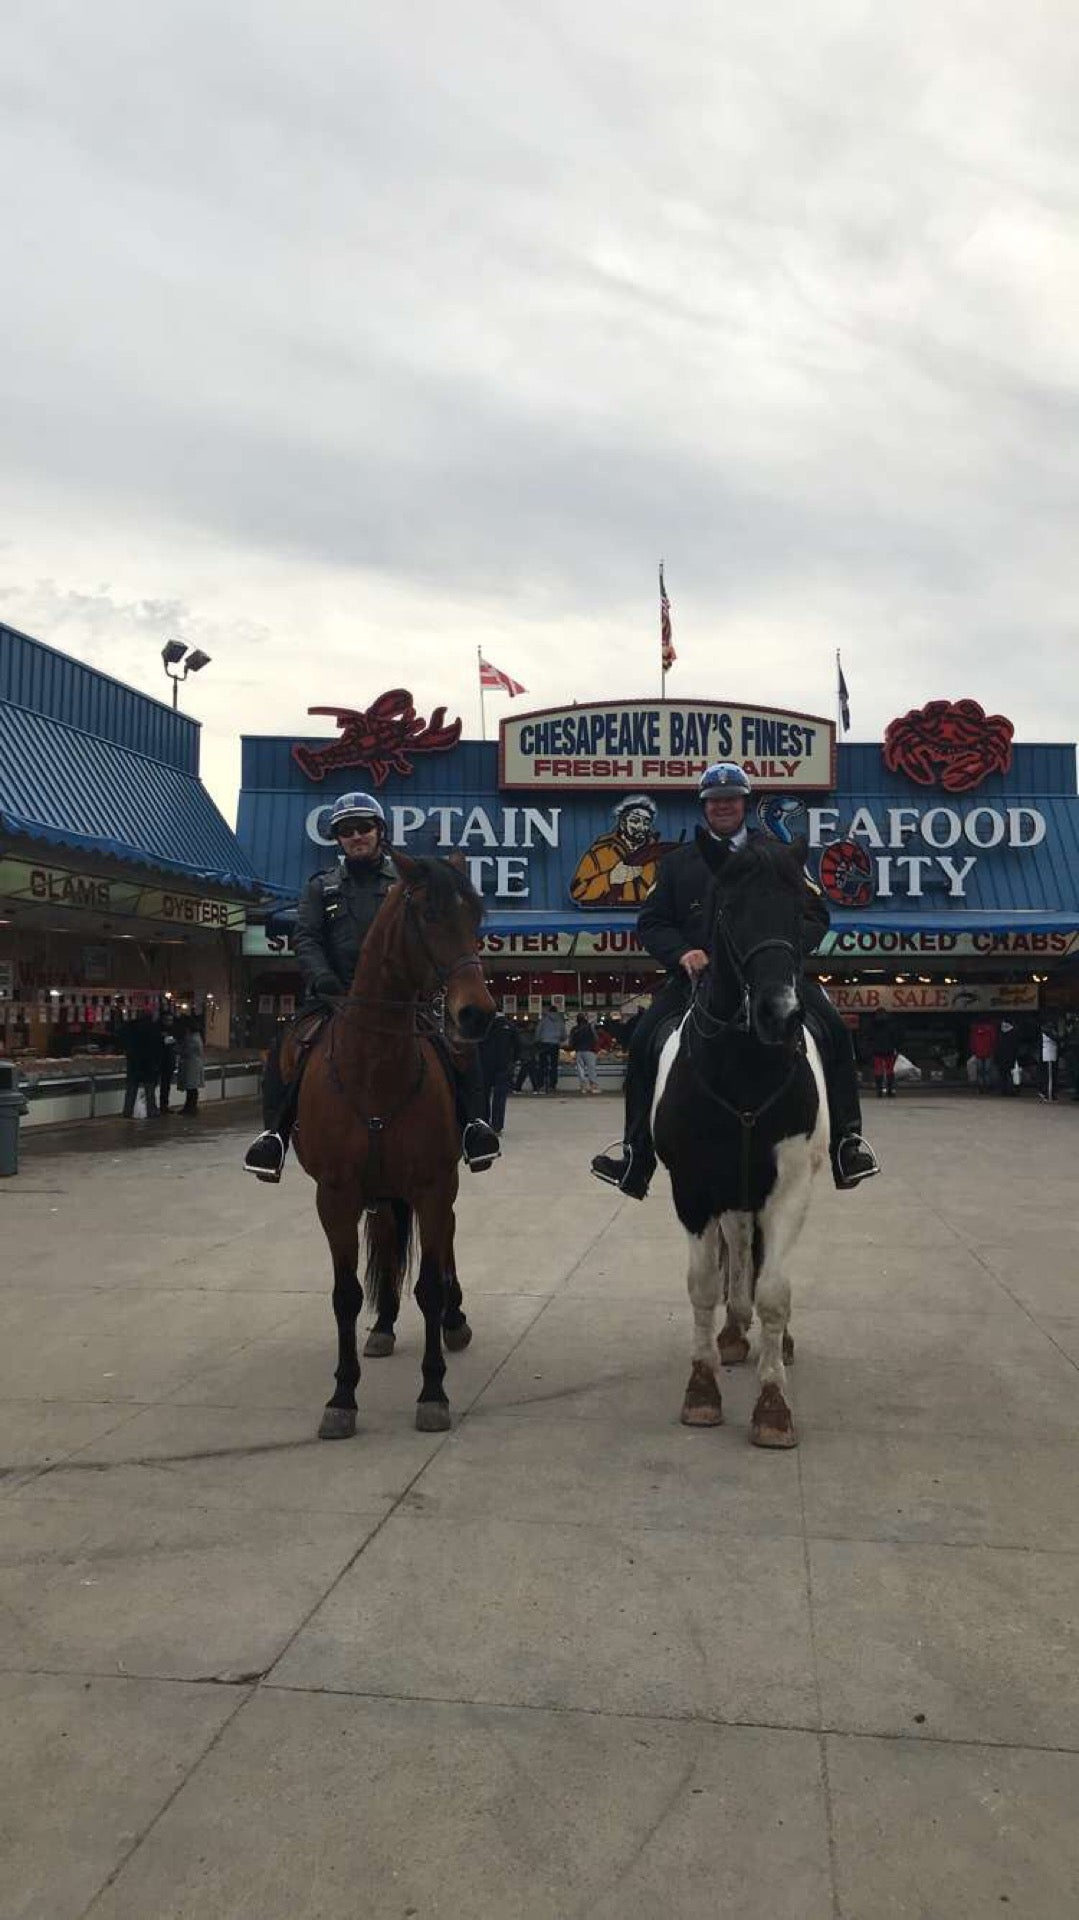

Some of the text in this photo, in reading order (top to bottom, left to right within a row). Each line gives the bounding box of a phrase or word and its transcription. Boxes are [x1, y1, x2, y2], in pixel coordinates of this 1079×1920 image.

[520, 711, 816, 757] CHESAPEAKE BAY'S FINEST
[534, 759, 801, 777] FRESH FISH AILY
[305, 804, 562, 849] CPTAIN
[30, 870, 111, 904] CLAMS
[162, 895, 228, 925] OYSTERS
[838, 932, 1067, 953] COOKED CRABS
[892, 990, 949, 1008] SALE
